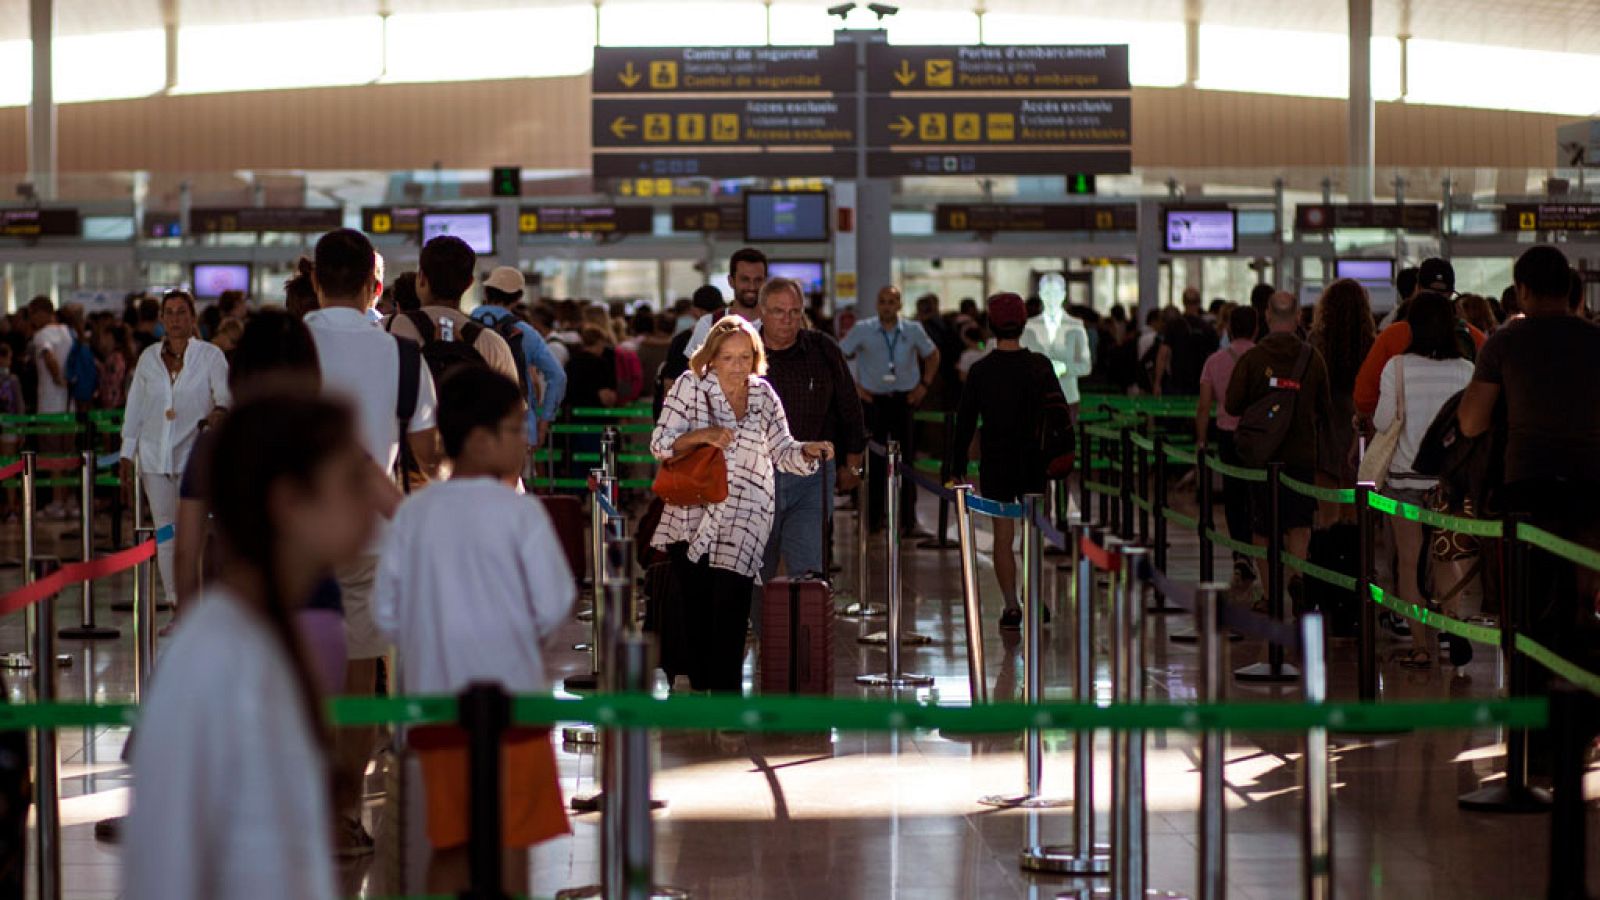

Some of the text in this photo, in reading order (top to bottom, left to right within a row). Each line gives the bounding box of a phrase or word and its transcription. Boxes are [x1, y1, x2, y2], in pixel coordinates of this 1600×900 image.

[685, 48, 733, 60] Control
[735, 48, 752, 60] de
[958, 47, 1001, 59] Portes
[684, 75, 732, 87] Control
[735, 75, 751, 87] de
[958, 73, 1098, 88] Puertas de embarque
